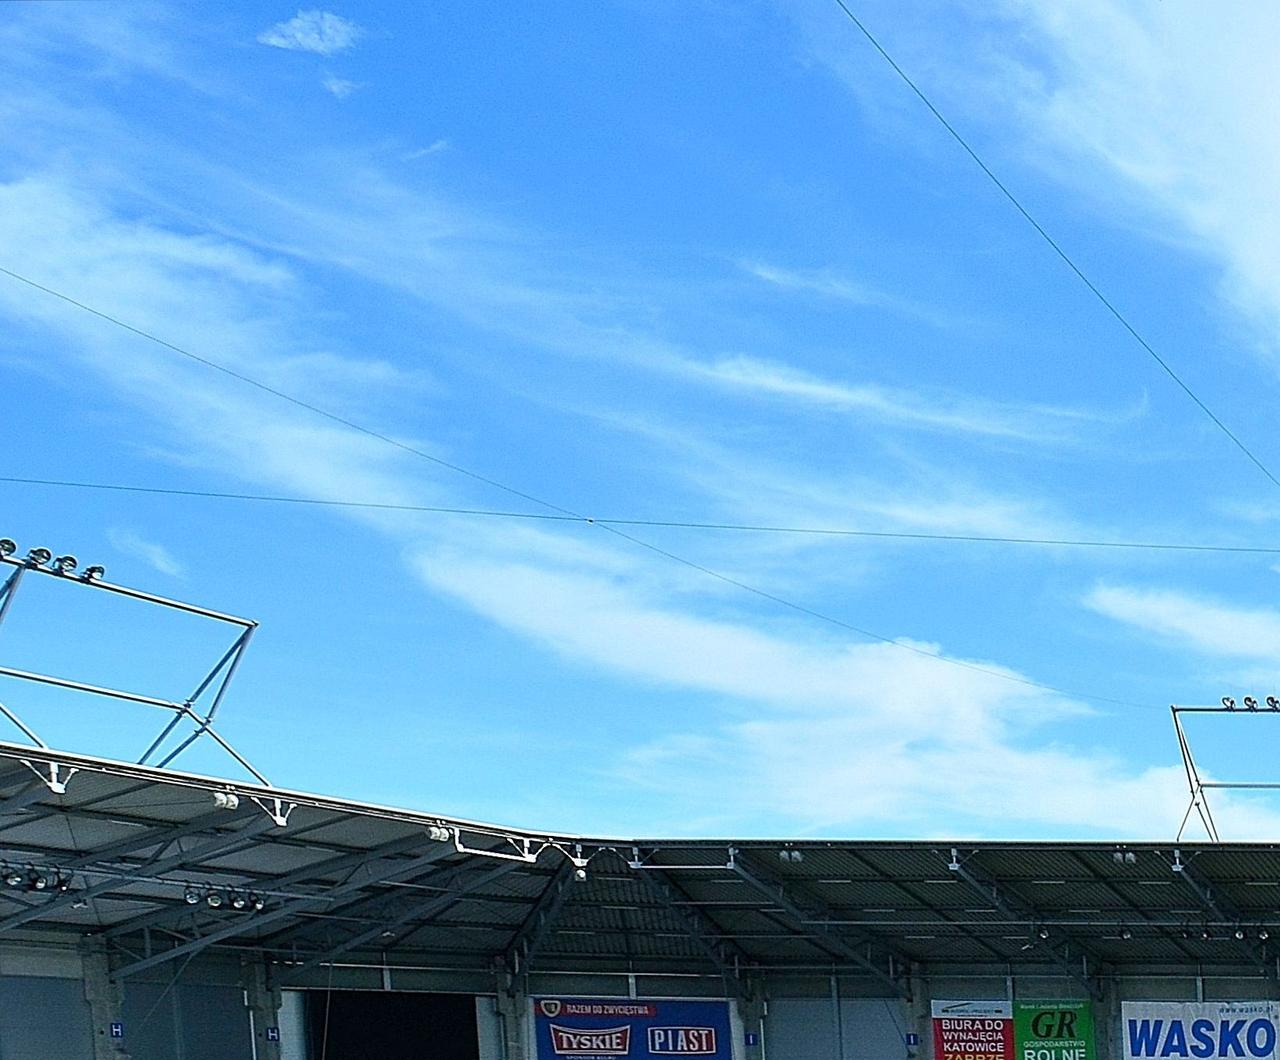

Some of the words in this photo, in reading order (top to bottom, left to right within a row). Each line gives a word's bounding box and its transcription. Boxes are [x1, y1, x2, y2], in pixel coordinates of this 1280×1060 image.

[566, 1004, 592, 1014] RAZEM
[592, 1005, 602, 1014] DO
[1219, 1005, 1274, 1014] www.wasko.pl
[942, 1019, 983, 1030] BIURA
[985, 1020, 1003, 1030] DO
[1031, 1010, 1077, 1039] GR
[559, 1032, 623, 1049] TYSKIE
[654, 1030, 709, 1051] PIAST
[942, 1031, 1003, 1042] WYNAJĘCIA
[1128, 1018, 1276, 1059] WASKO
[943, 1042, 1004, 1052] KATOWICE
[1023, 1040, 1086, 1048] GOSPODARSTWO
